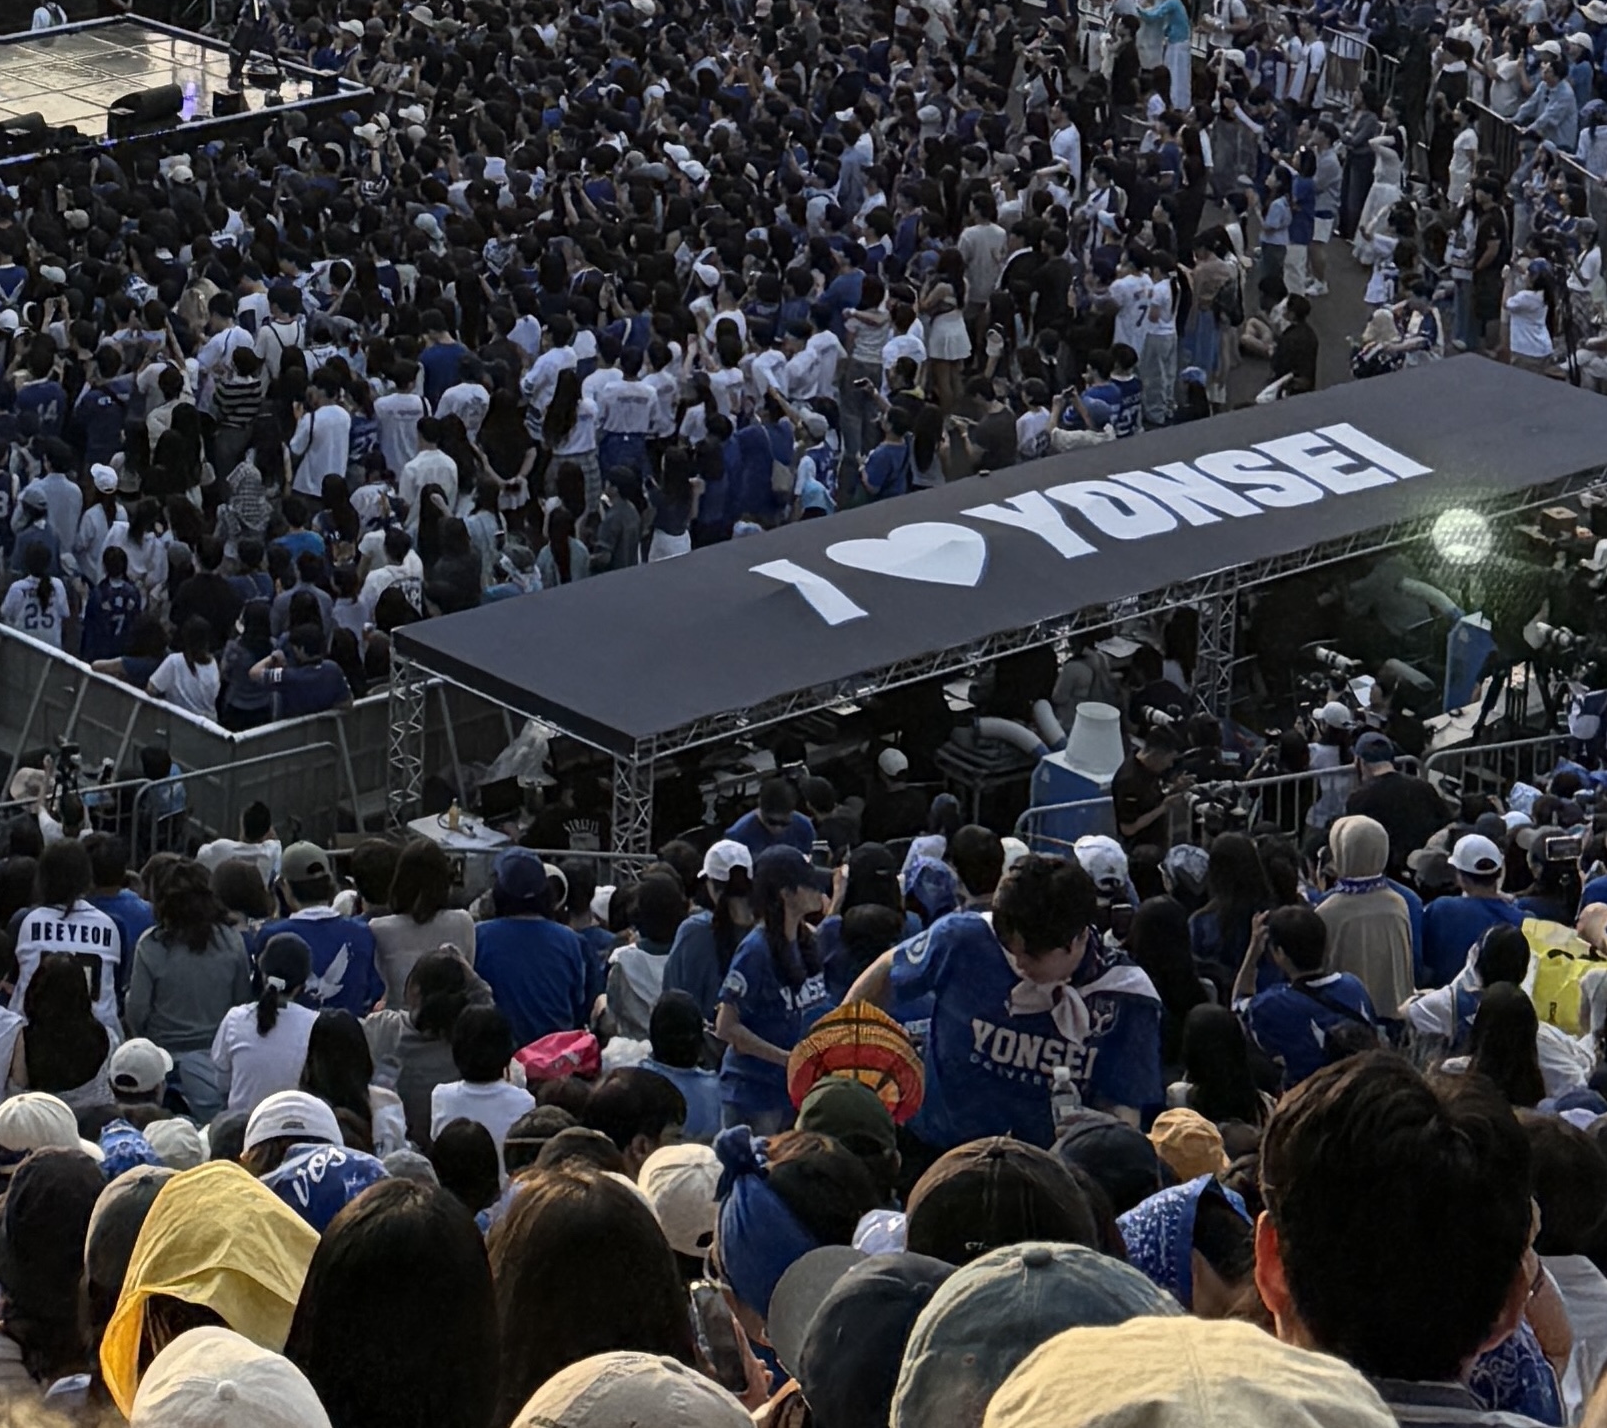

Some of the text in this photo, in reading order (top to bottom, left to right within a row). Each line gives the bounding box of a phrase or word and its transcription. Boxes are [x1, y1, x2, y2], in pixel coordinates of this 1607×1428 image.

[1136, 304, 1148, 328] 7
[749, 421, 1434, 627] I YONSEI
[24, 603, 55, 630] 25
[971, 1017, 1099, 1080] YONSEI
